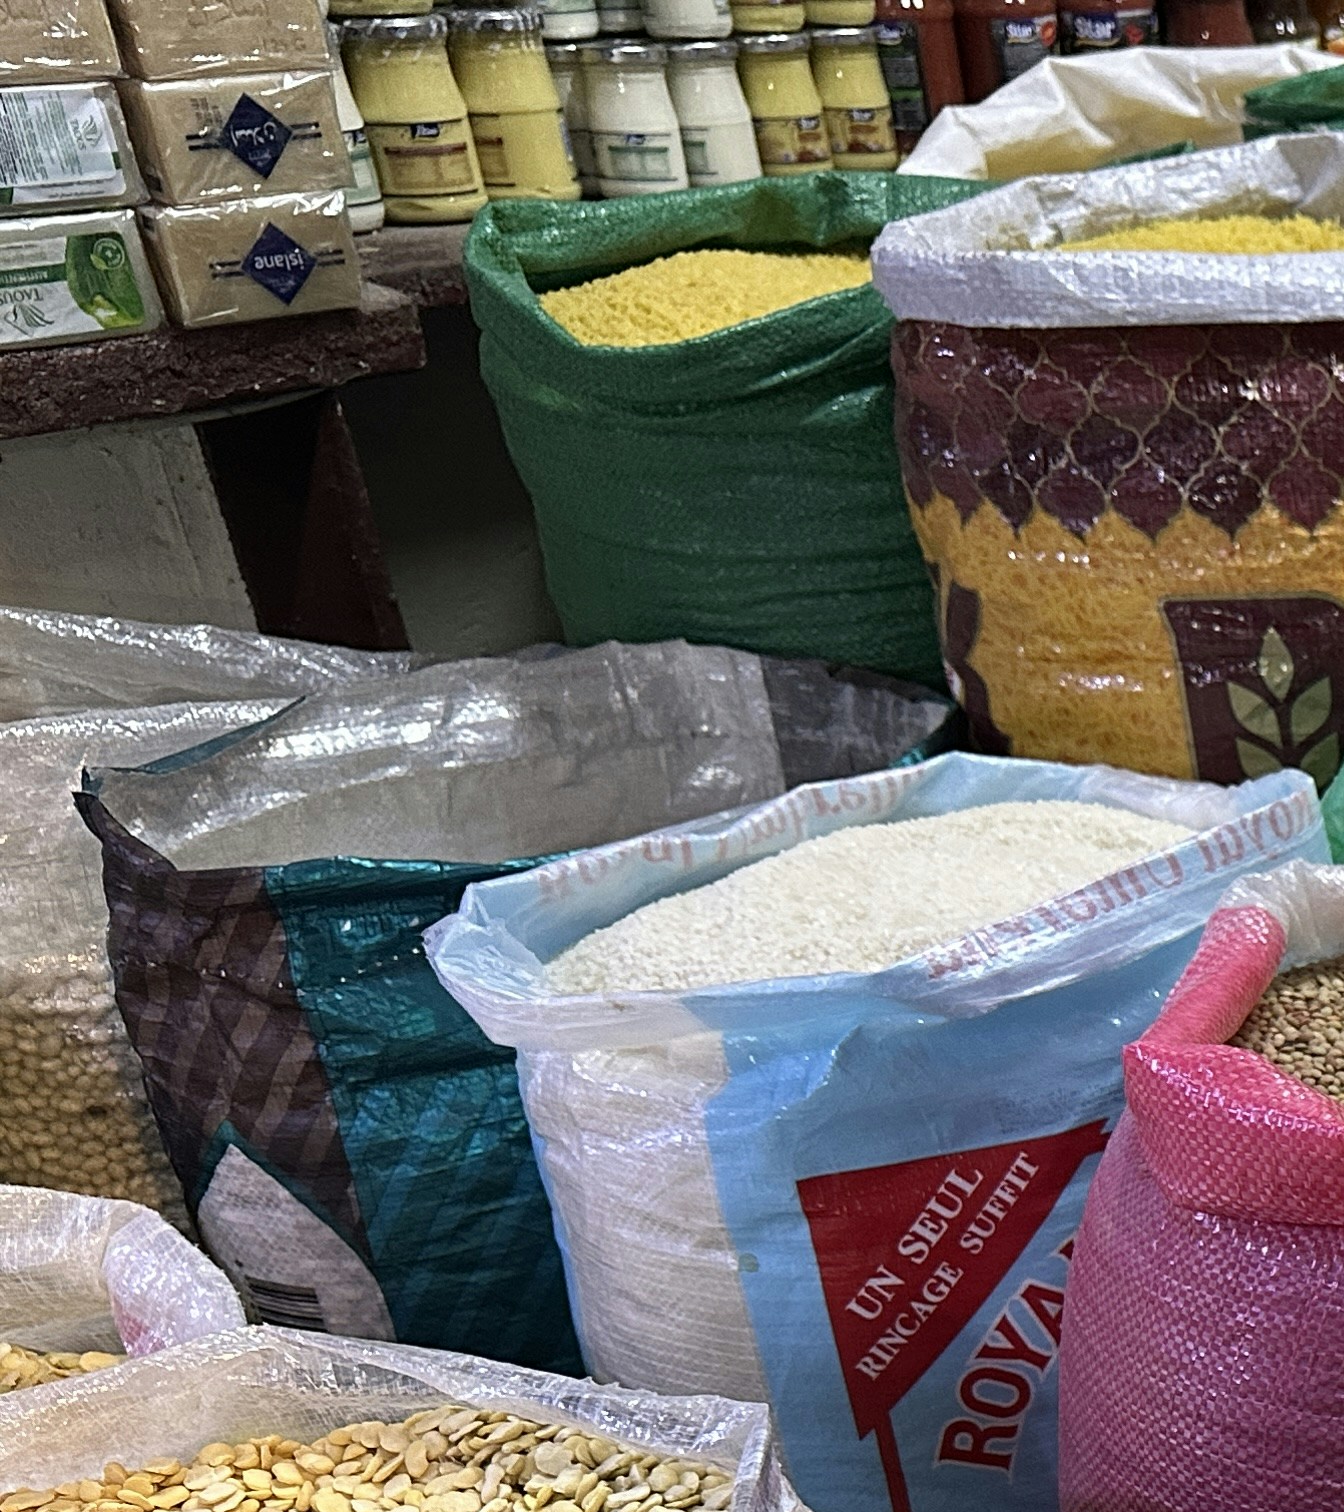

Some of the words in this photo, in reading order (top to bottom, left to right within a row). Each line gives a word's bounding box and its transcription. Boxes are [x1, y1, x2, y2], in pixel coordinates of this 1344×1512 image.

[253, 250, 305, 271] islane
[845, 1264, 906, 1321] UN
[898, 1167, 985, 1265] SEUL
[855, 1260, 965, 1381] RINCAGE
[959, 1151, 1040, 1255] SUFFIT
[934, 1236, 1077, 1475] ROYA
